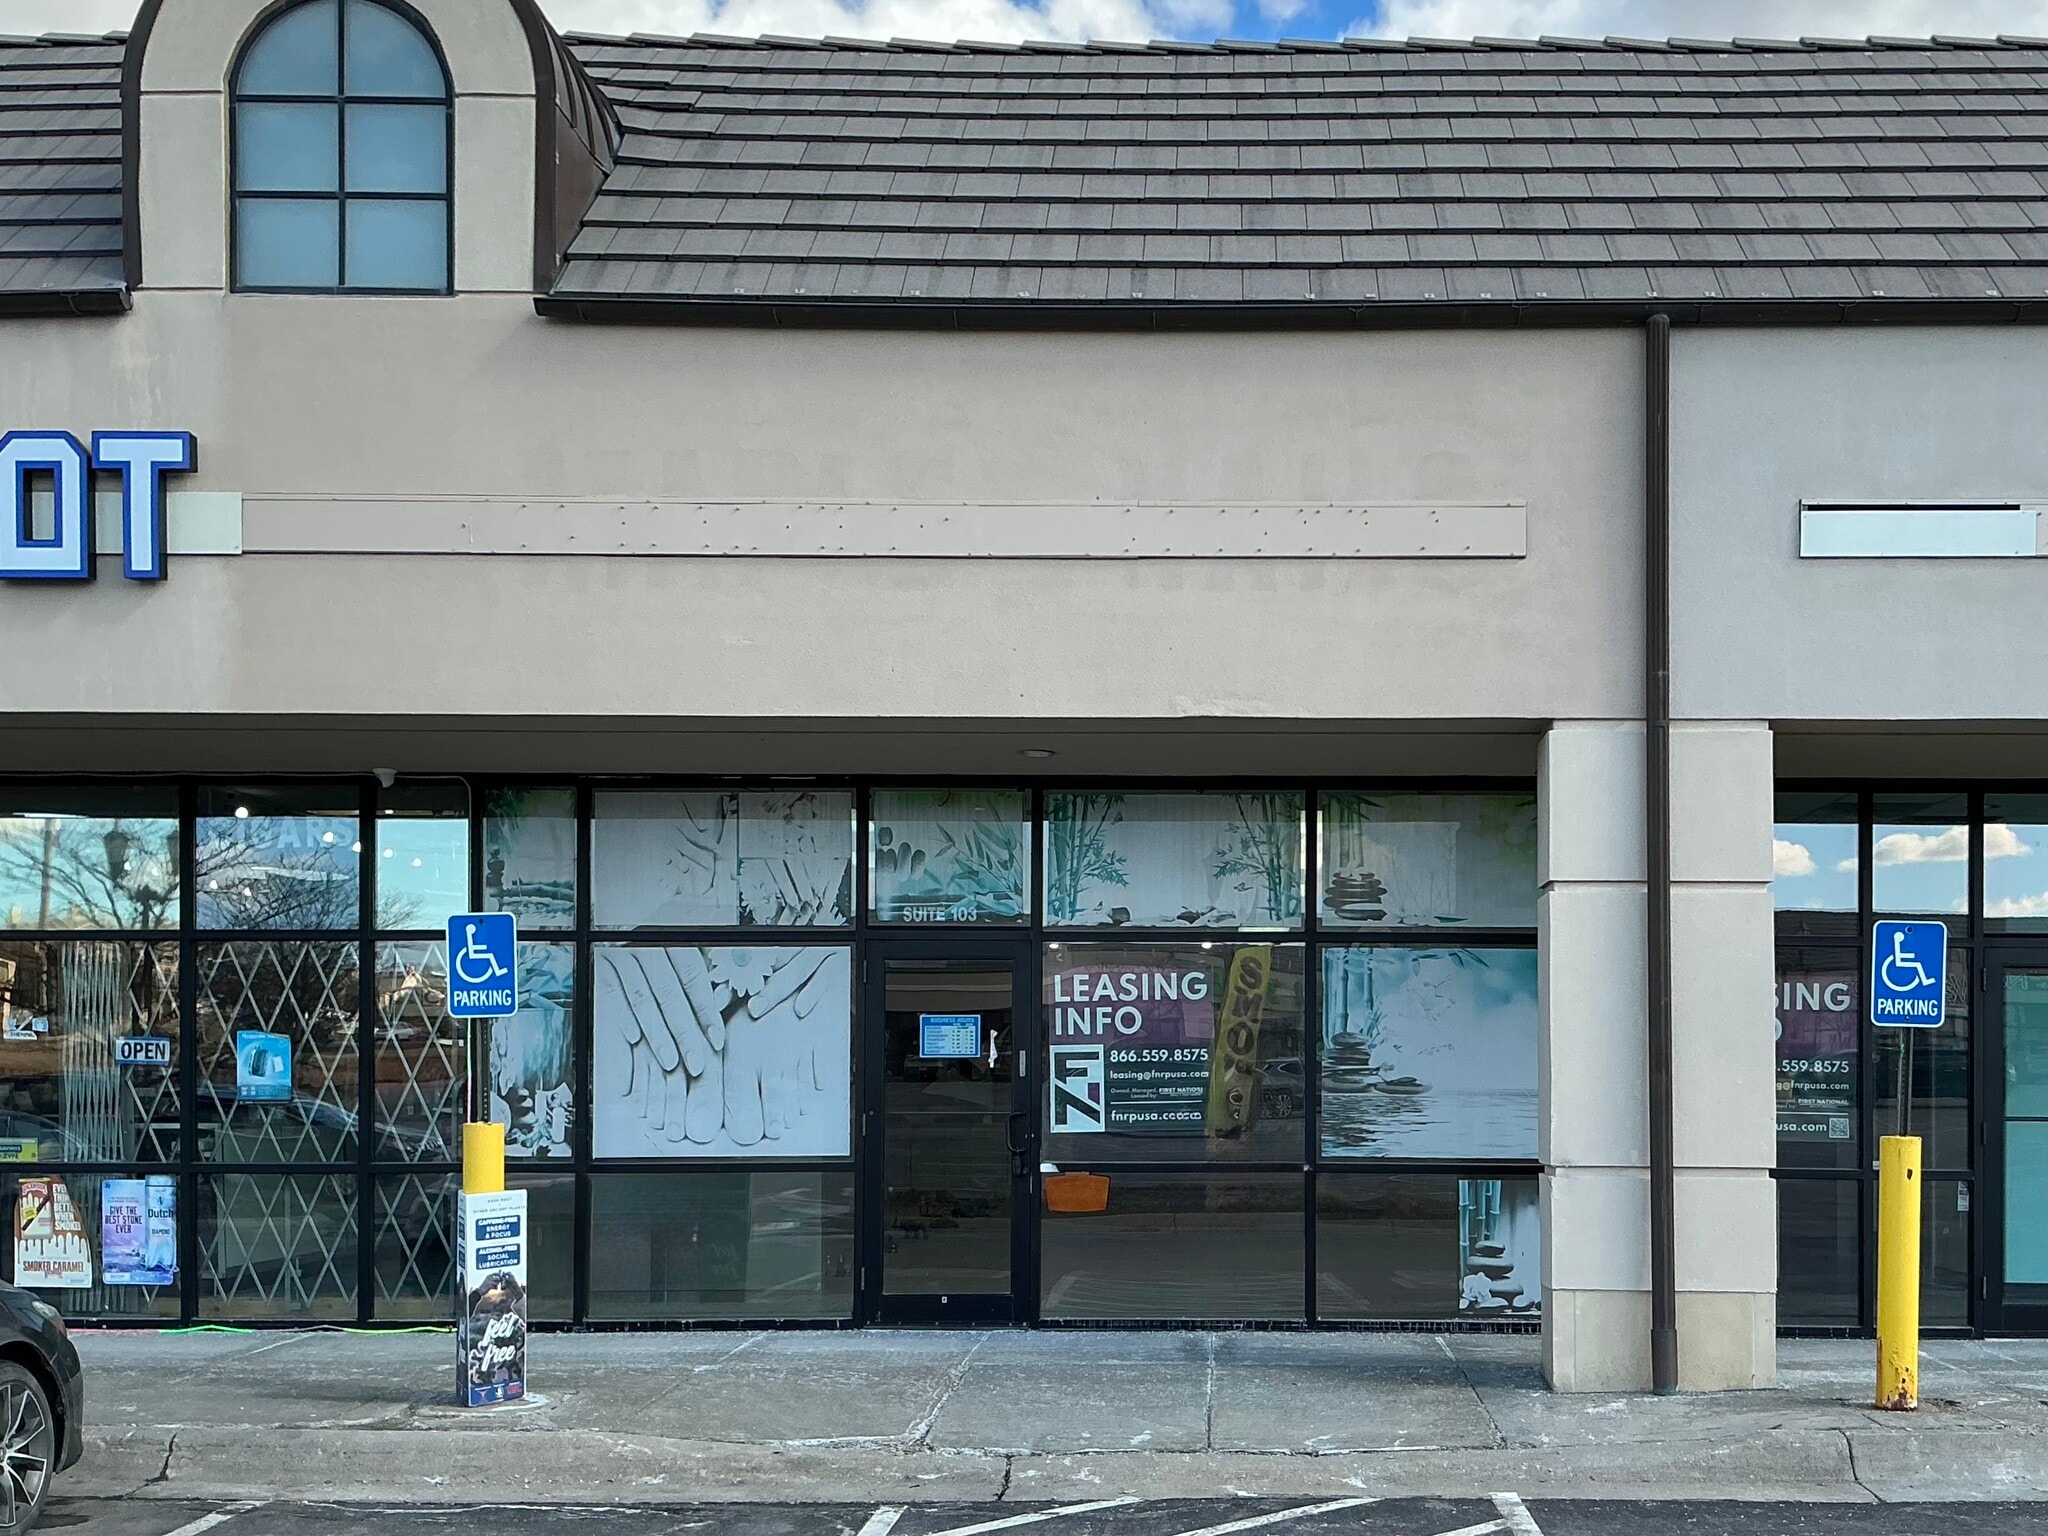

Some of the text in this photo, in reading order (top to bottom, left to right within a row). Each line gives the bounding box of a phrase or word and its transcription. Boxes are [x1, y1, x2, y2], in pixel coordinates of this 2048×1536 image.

[0, 430, 198, 580] OT
[903, 907, 977, 922] SUITE 103
[1054, 971, 1208, 1002] LEASING
[453, 989, 512, 1007] PARKING
[1877, 998, 1938, 1016] PARKING
[1055, 1006, 1142, 1035] INFO
[121, 1042, 166, 1060] OPEN
[1109, 1049, 1209, 1063] 866.559.8575
[1110, 1069, 1209, 1080] leasing@fnrpusa.com
[110, 1205, 137, 1215] GIVE THE
[147, 1208, 175, 1218] Dutch
[105, 1215, 142, 1224] BEST STONE
[115, 1224, 132, 1234] EVER
[486, 1224, 510, 1232] ENERGY
[23, 1260, 84, 1272] SMOKED CARAMEL
[478, 1258, 518, 1269] LUBRICATION
[481, 1312, 519, 1347] feel
[481, 1343, 516, 1372] free
